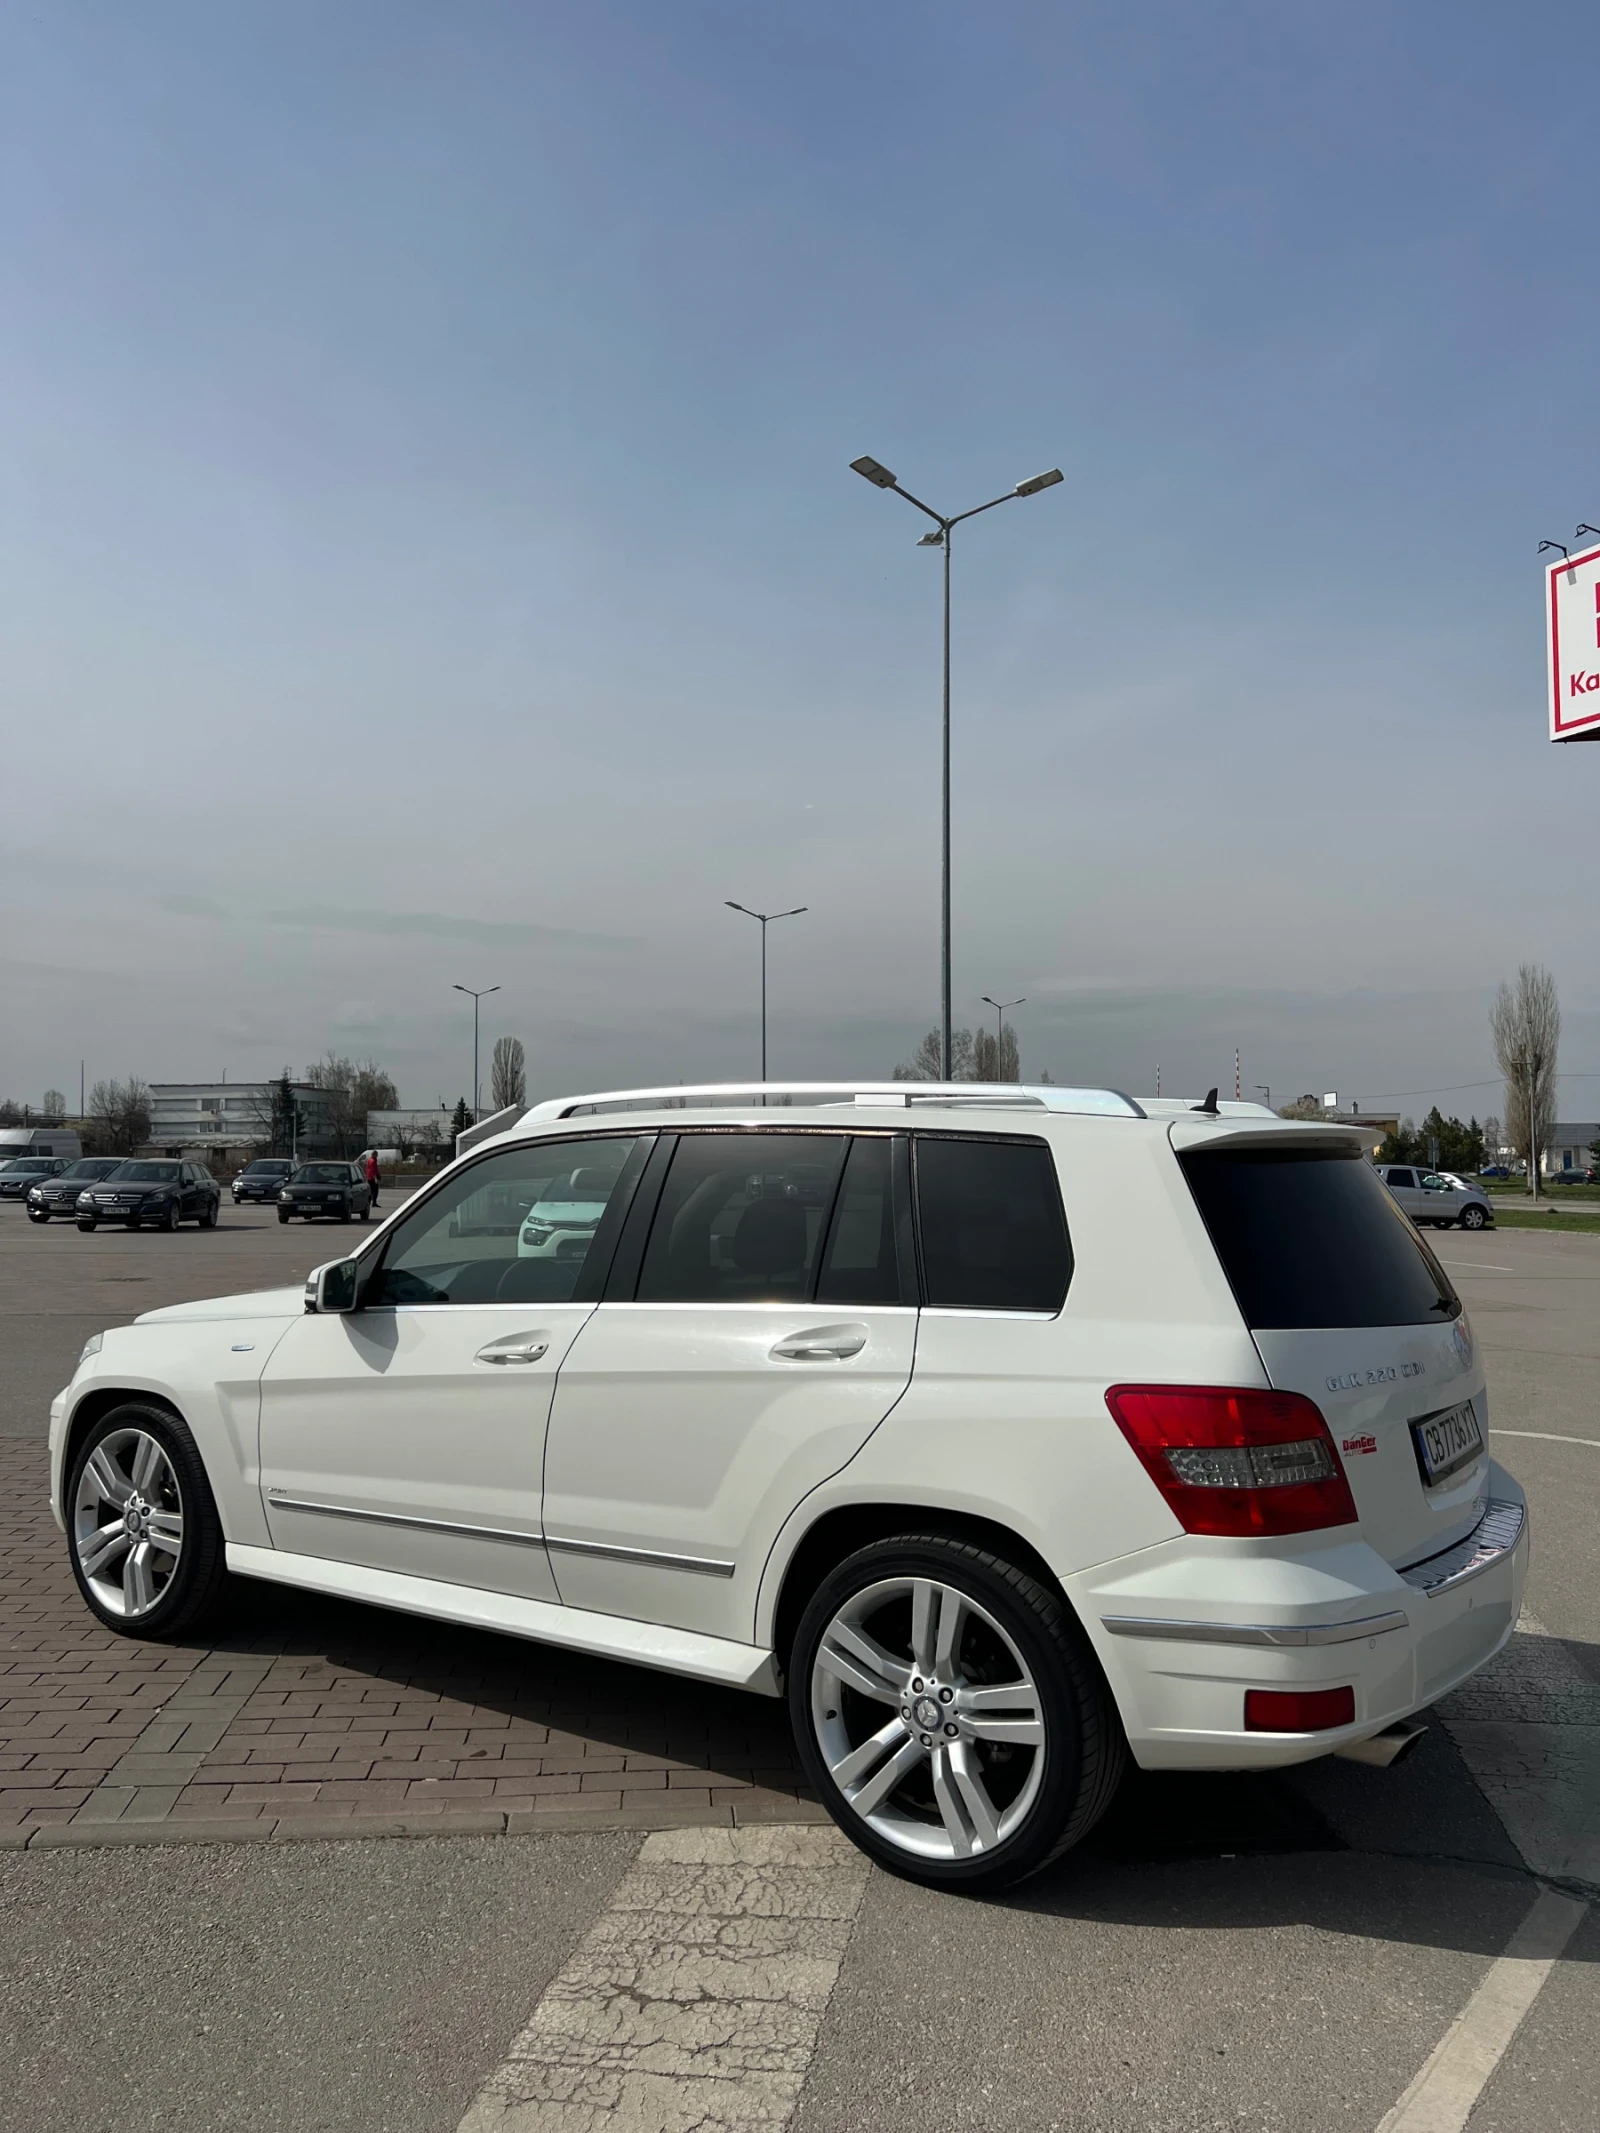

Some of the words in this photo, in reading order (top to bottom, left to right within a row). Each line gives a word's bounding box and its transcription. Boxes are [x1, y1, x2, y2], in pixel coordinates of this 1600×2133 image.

[1326, 1372, 1363, 1392] GLK
[1366, 1366, 1398, 1384] 220
[1401, 1360, 1425, 1378] CDI
[1342, 1436, 1376, 1451] DanGer
[1344, 1449, 1362, 1457] AUTO
